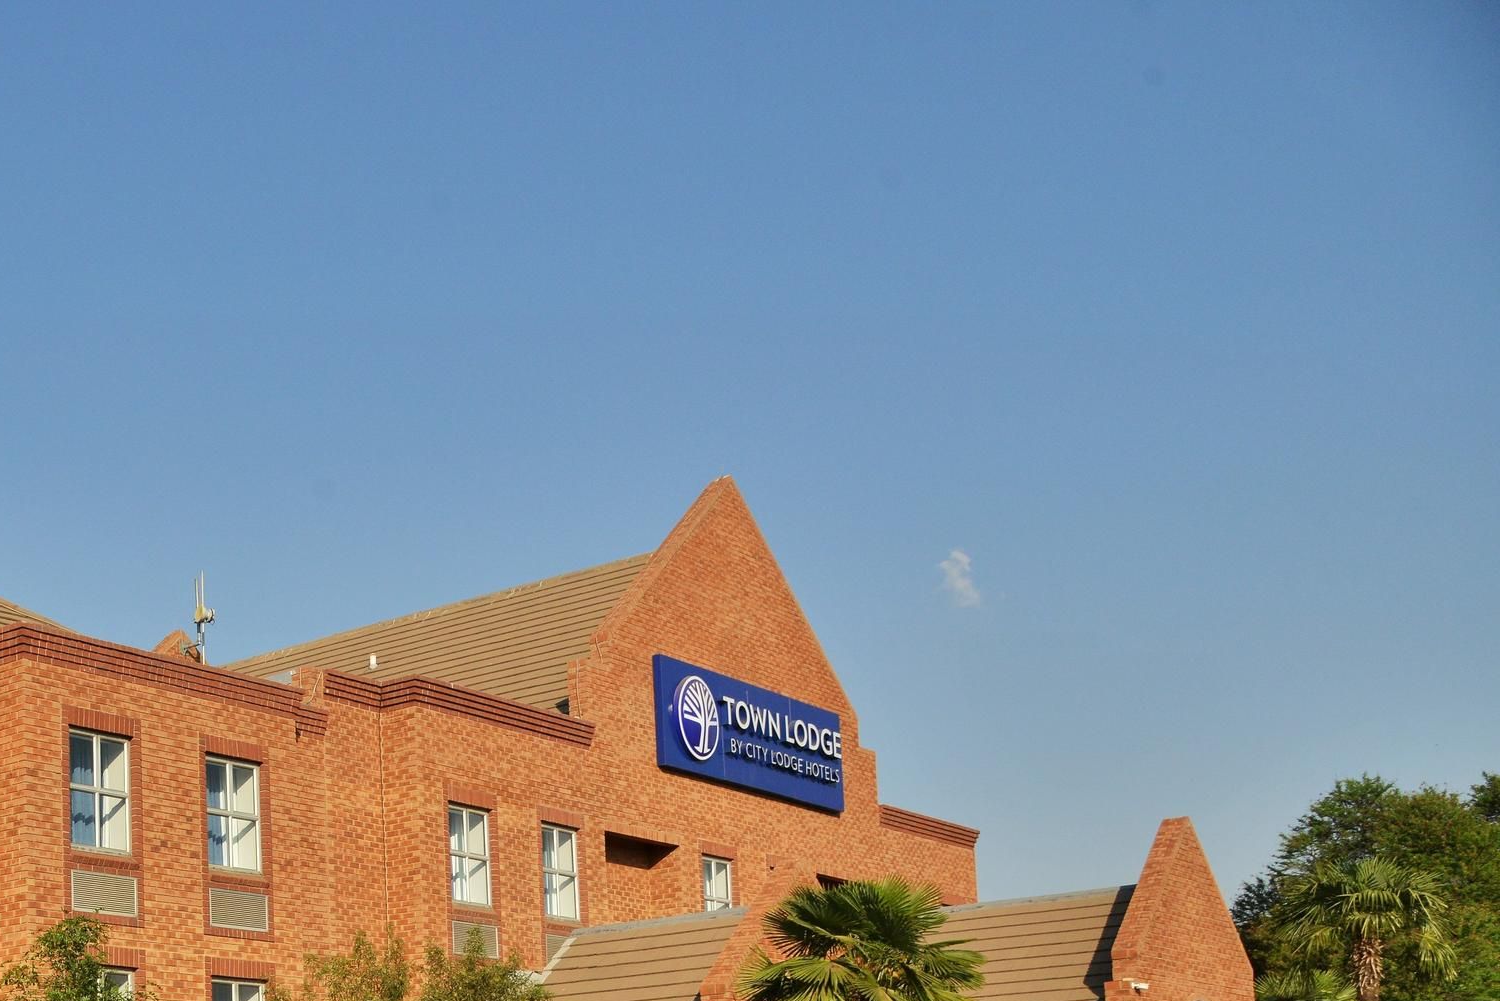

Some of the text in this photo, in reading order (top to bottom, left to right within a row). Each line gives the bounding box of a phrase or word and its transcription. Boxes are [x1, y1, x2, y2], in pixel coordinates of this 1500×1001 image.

[722, 695, 842, 760] TOWN LODGE
[730, 738, 840, 783] BY CITY LODGE HOTELS
